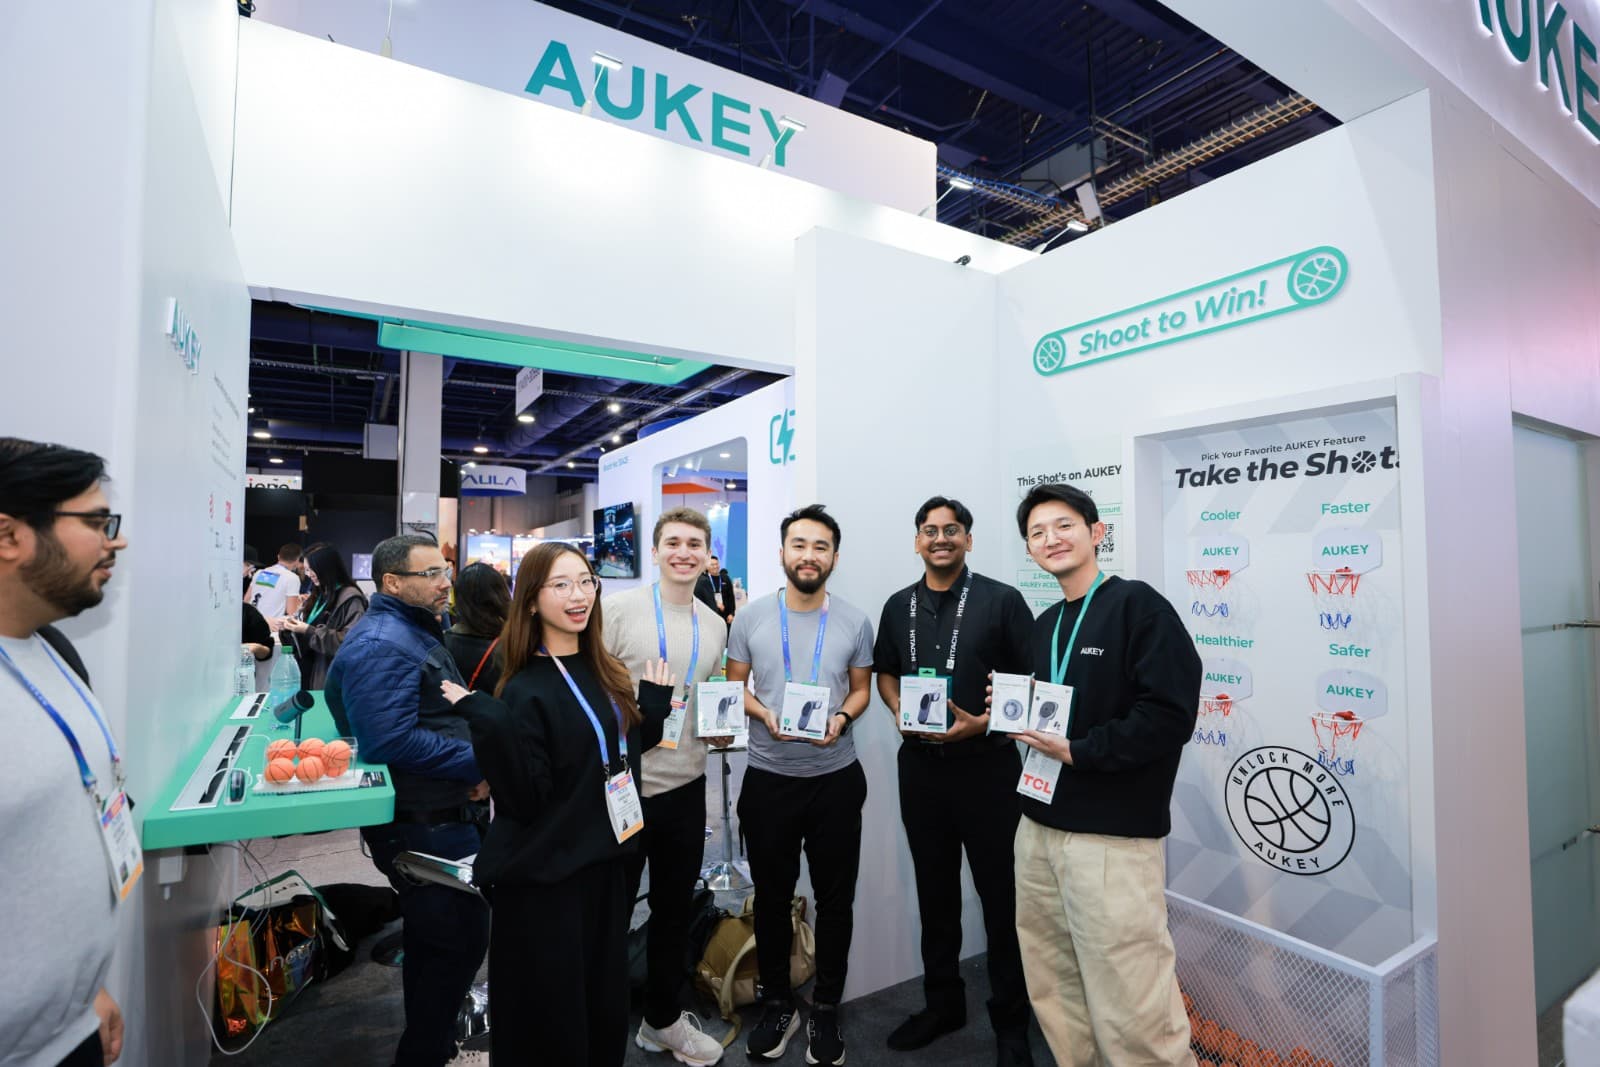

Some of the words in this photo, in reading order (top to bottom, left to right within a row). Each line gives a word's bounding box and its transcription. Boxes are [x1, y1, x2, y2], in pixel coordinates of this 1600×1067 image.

[524, 40, 799, 167] AUKEY
[1079, 316, 1151, 355] Shoot
[1158, 310, 1187, 333] to
[1195, 280, 1268, 323] Win!
[1201, 453, 1219, 461] Pick
[1222, 450, 1242, 459] Your
[1244, 445, 1282, 456] Favorite
[1284, 440, 1320, 451] AUKEY
[1323, 435, 1366, 446] Feature
[462, 474, 519, 486] AULA
[1017, 475, 1036, 487] This
[1037, 472, 1066, 485] Shot's
[1068, 471, 1082, 481] on
[1084, 464, 1122, 479] AUKEY
[1175, 464, 1241, 488] Take
[1247, 458, 1299, 481] the
[1200, 509, 1241, 522] Cooler
[1321, 502, 1371, 515] Faster
[1202, 546, 1240, 557] AUKEY
[1321, 544, 1369, 557] AUKEY
[956, 587, 970, 617] HITACHI
[949, 629, 960, 660] HITACHI
[1195, 633, 1254, 649] Healthier
[1080, 648, 1104, 656] AUKEY
[1329, 643, 1371, 658] Safer
[1205, 672, 1242, 685] AUKEY
[1326, 684, 1375, 700] AUKEY
[1023, 773, 1052, 794] TCL
[1232, 751, 1289, 786] UNLOCK
[1302, 761, 1344, 807] MORE
[1254, 841, 1320, 870] AUKEY
